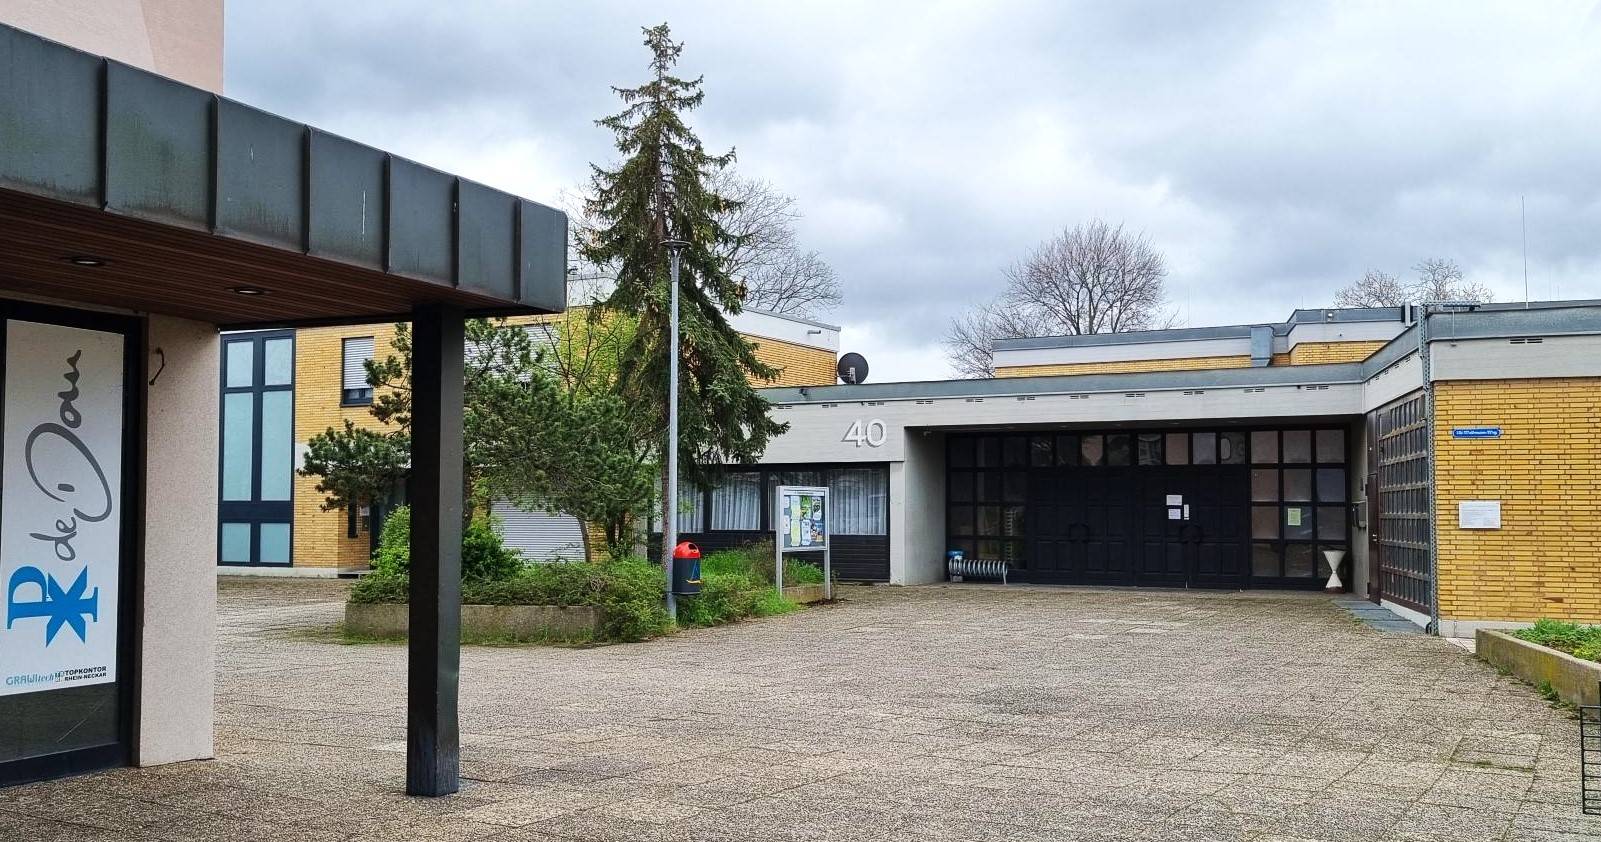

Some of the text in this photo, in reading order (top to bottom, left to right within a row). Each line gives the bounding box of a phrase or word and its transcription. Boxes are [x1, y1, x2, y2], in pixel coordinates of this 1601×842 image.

[840, 419, 887, 448] 40
[30, 515, 77, 561] de
[65, 666, 107, 676] TOPKONTOR
[65, 672, 107, 681] RHEIN-NECKAR
